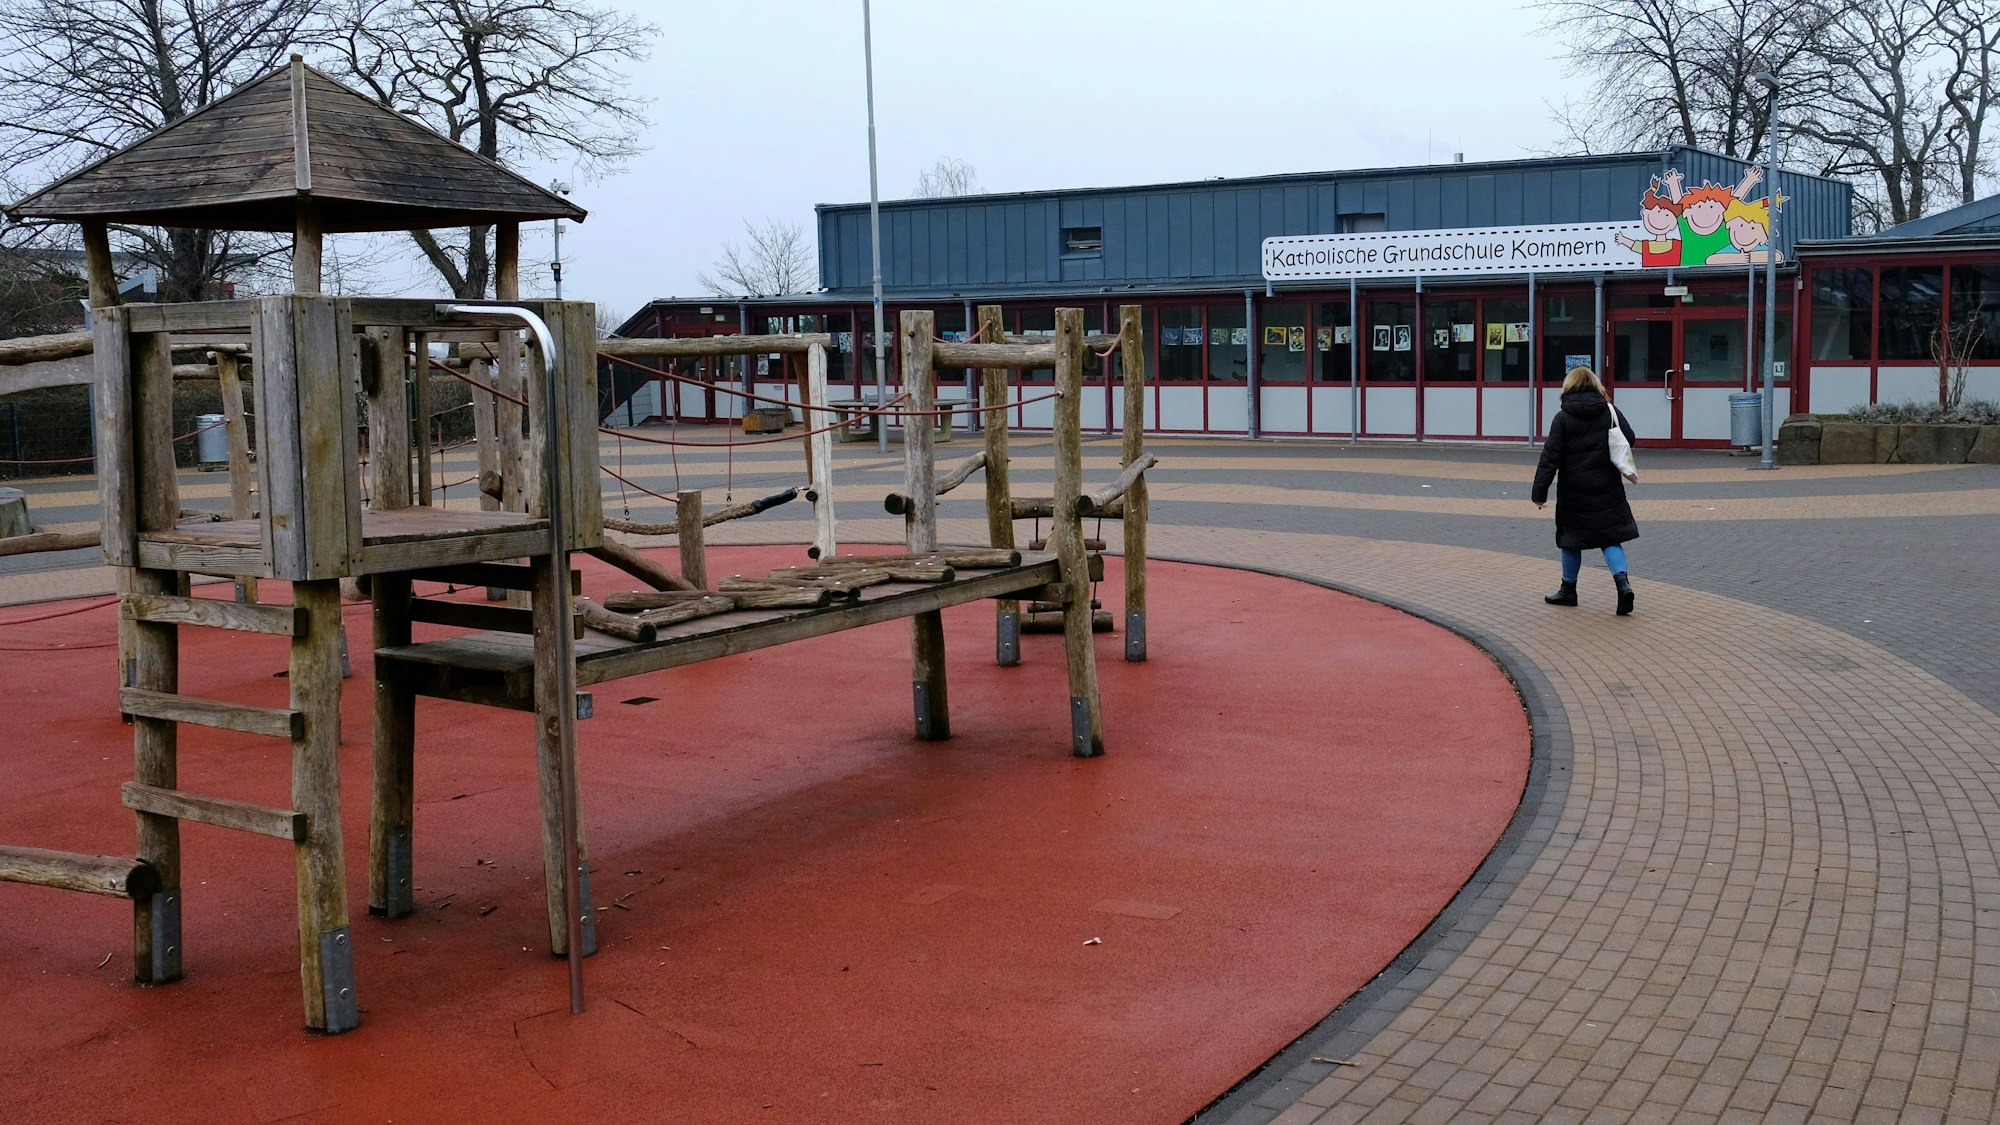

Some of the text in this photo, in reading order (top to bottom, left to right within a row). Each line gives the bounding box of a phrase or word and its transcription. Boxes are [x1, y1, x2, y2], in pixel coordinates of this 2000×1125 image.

[1272, 239, 1606, 268] Katholische Grundschule Kommern
